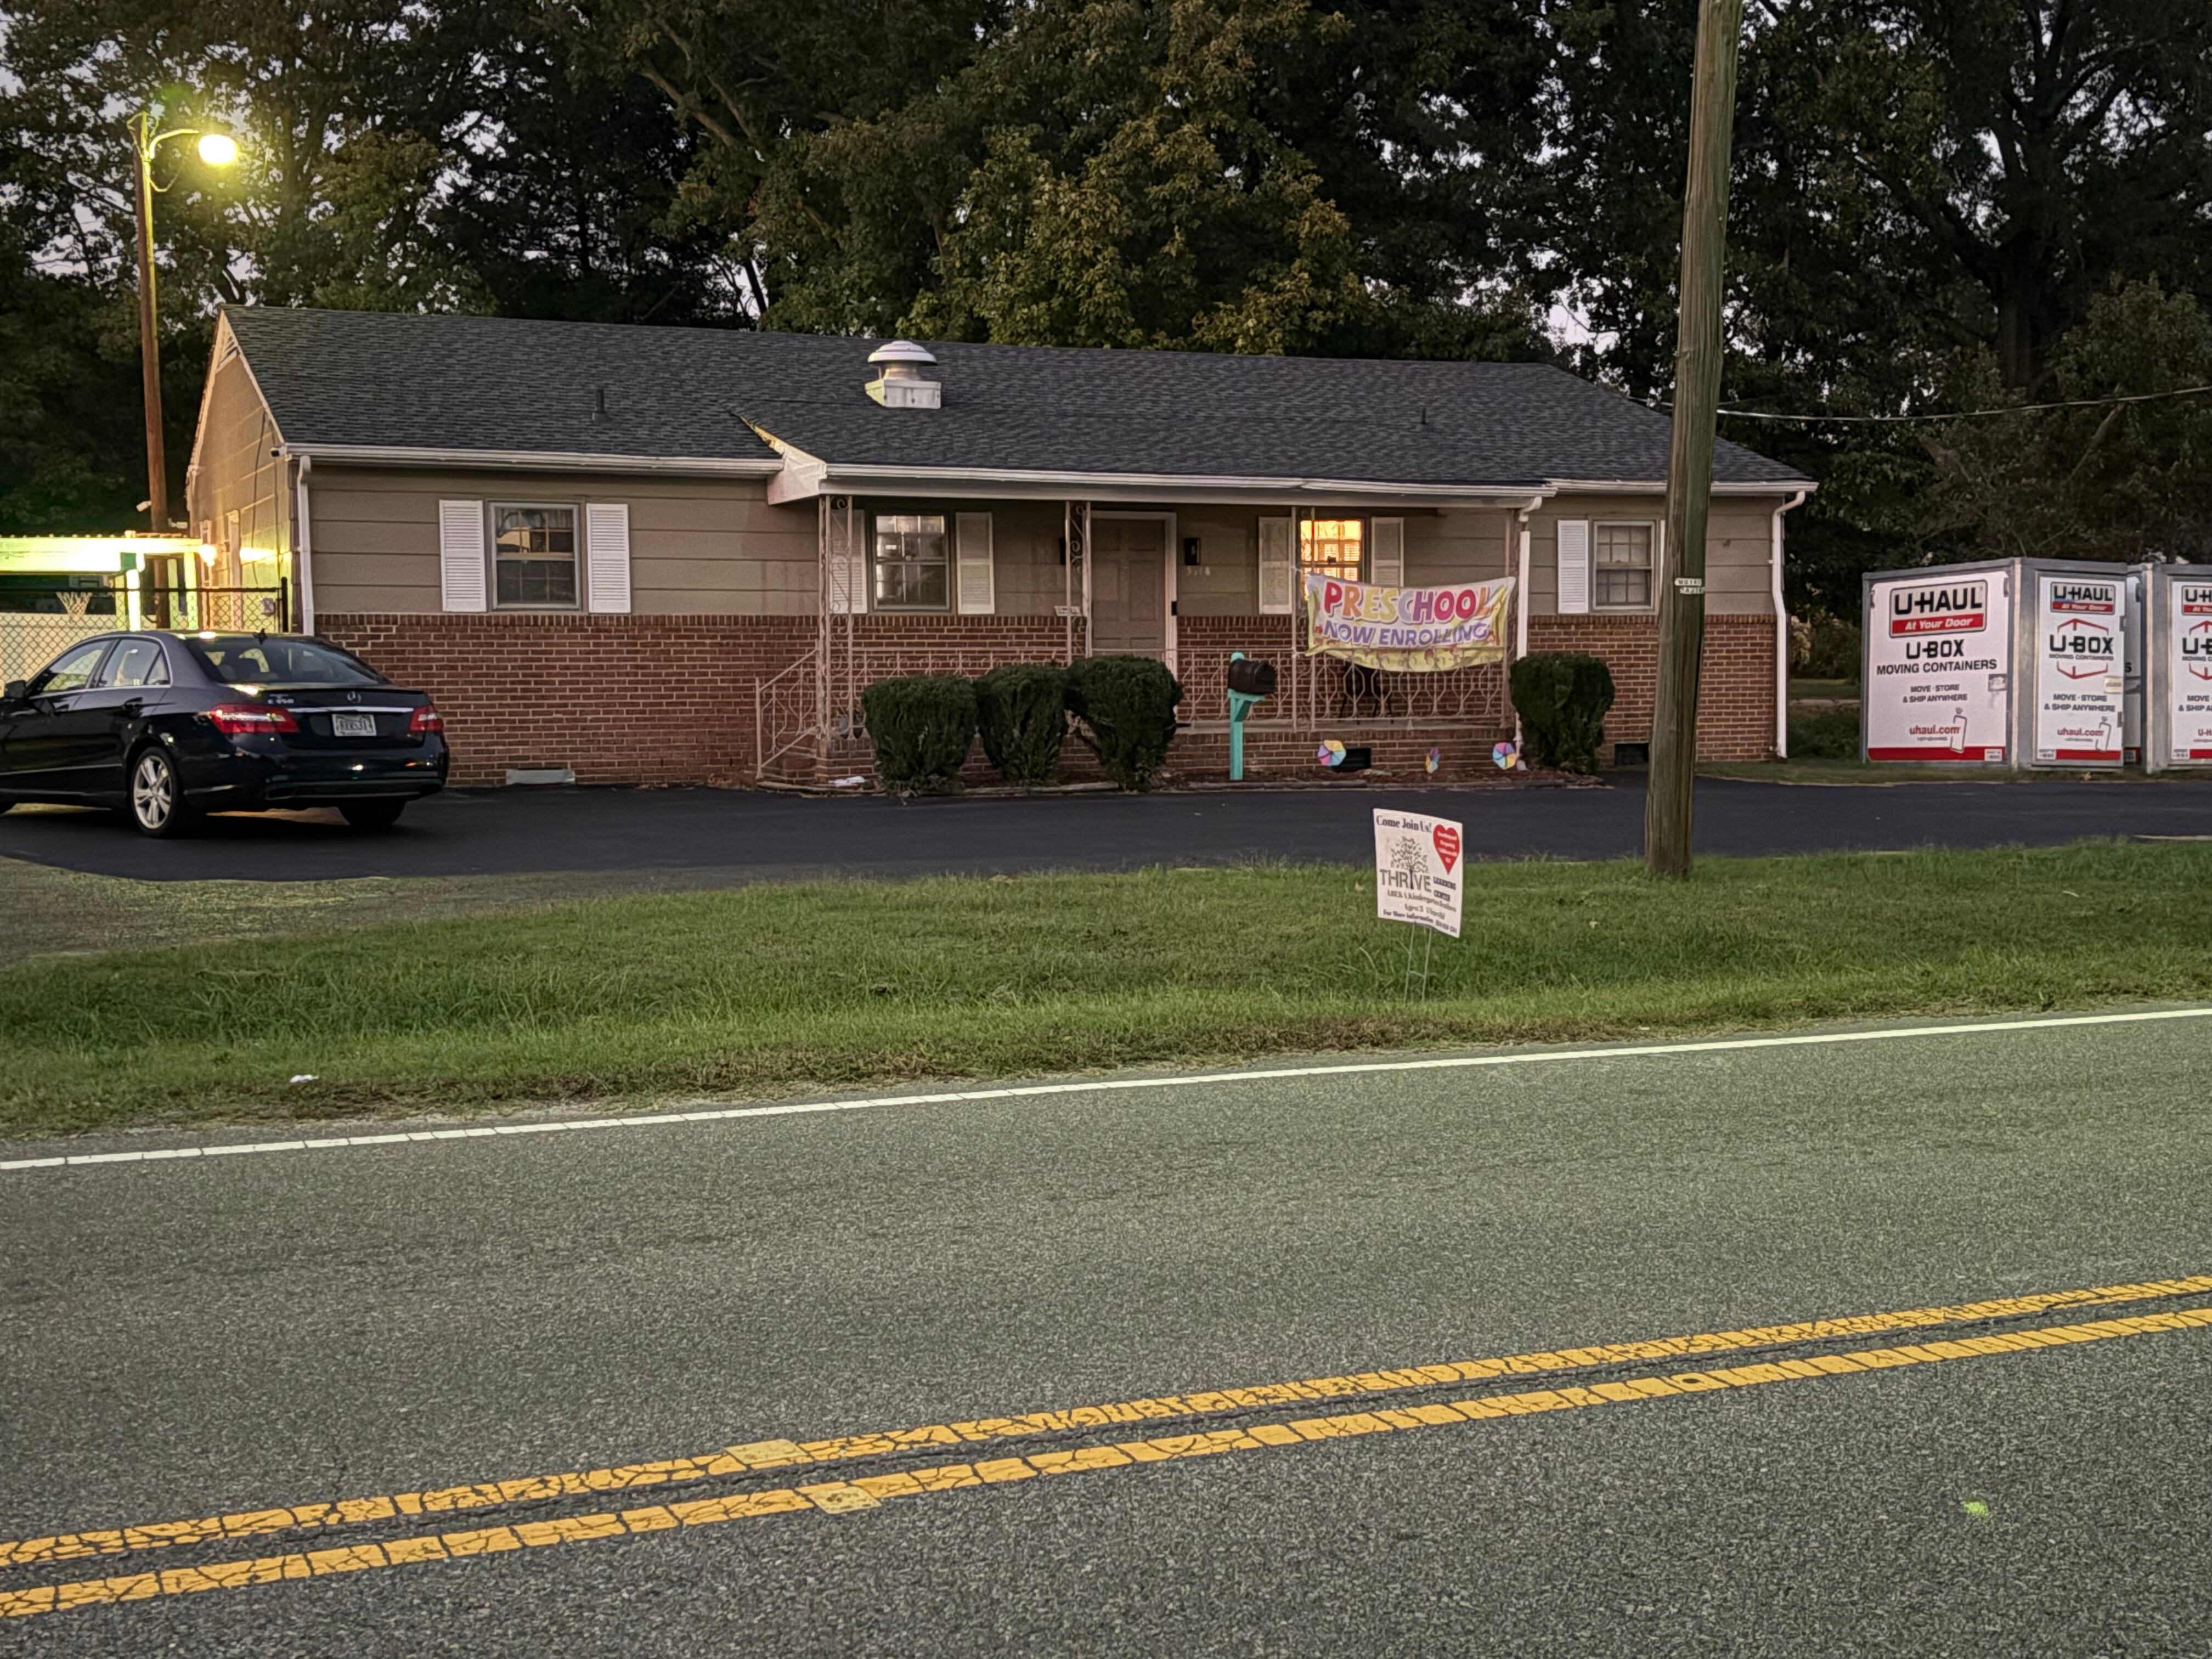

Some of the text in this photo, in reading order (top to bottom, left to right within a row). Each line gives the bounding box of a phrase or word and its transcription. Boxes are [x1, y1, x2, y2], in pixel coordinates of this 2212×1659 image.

[1895, 588, 1983, 614] U-HAUL
[2054, 586, 2113, 601] U-HAUL
[1324, 582, 1491, 622] PRESCHOOL
[1905, 618, 1973, 630] At Your Door
[1324, 620, 1489, 646] NOW ENROLLING
[1906, 639, 1965, 659] U-BOX
[2050, 634, 2114, 654] U-BOX
[1877, 659, 1997, 675] MOVING CONTAINERS
[1927, 694, 1968, 702] ANYWHERE
[2081, 694, 2107, 702] STORE
[1909, 725, 1960, 735] uhaul.com
[2057, 727, 2104, 736] uhaul.com
[1376, 815, 1400, 828] Come
[1402, 818, 1419, 831] Join
[1379, 869, 1431, 893] THRIVE
